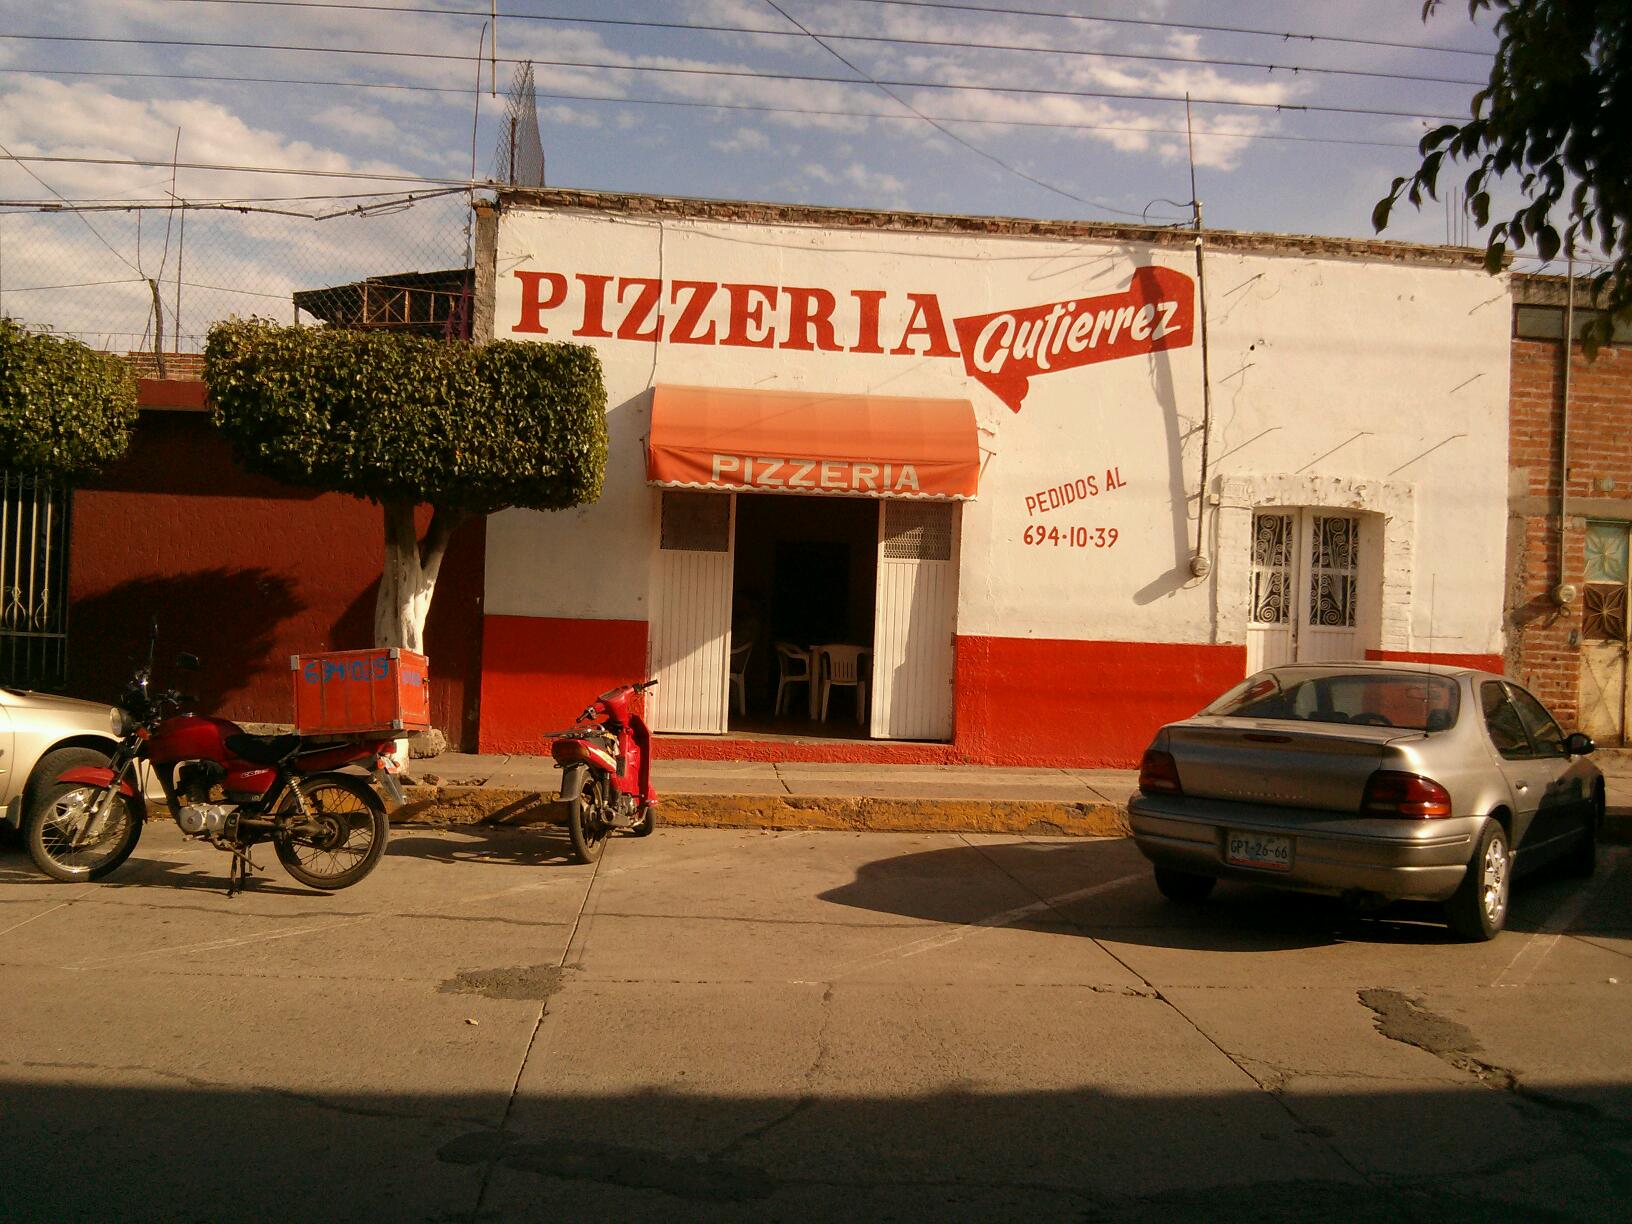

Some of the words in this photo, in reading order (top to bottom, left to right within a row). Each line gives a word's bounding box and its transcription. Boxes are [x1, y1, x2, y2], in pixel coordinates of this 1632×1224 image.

[512, 270, 961, 358] PIZZERIA
[974, 298, 1182, 373] Gutierrez
[711, 454, 921, 491] PIZZERIA
[1025, 475, 1099, 516] PEDIDOS
[1106, 467, 1127, 491] AL
